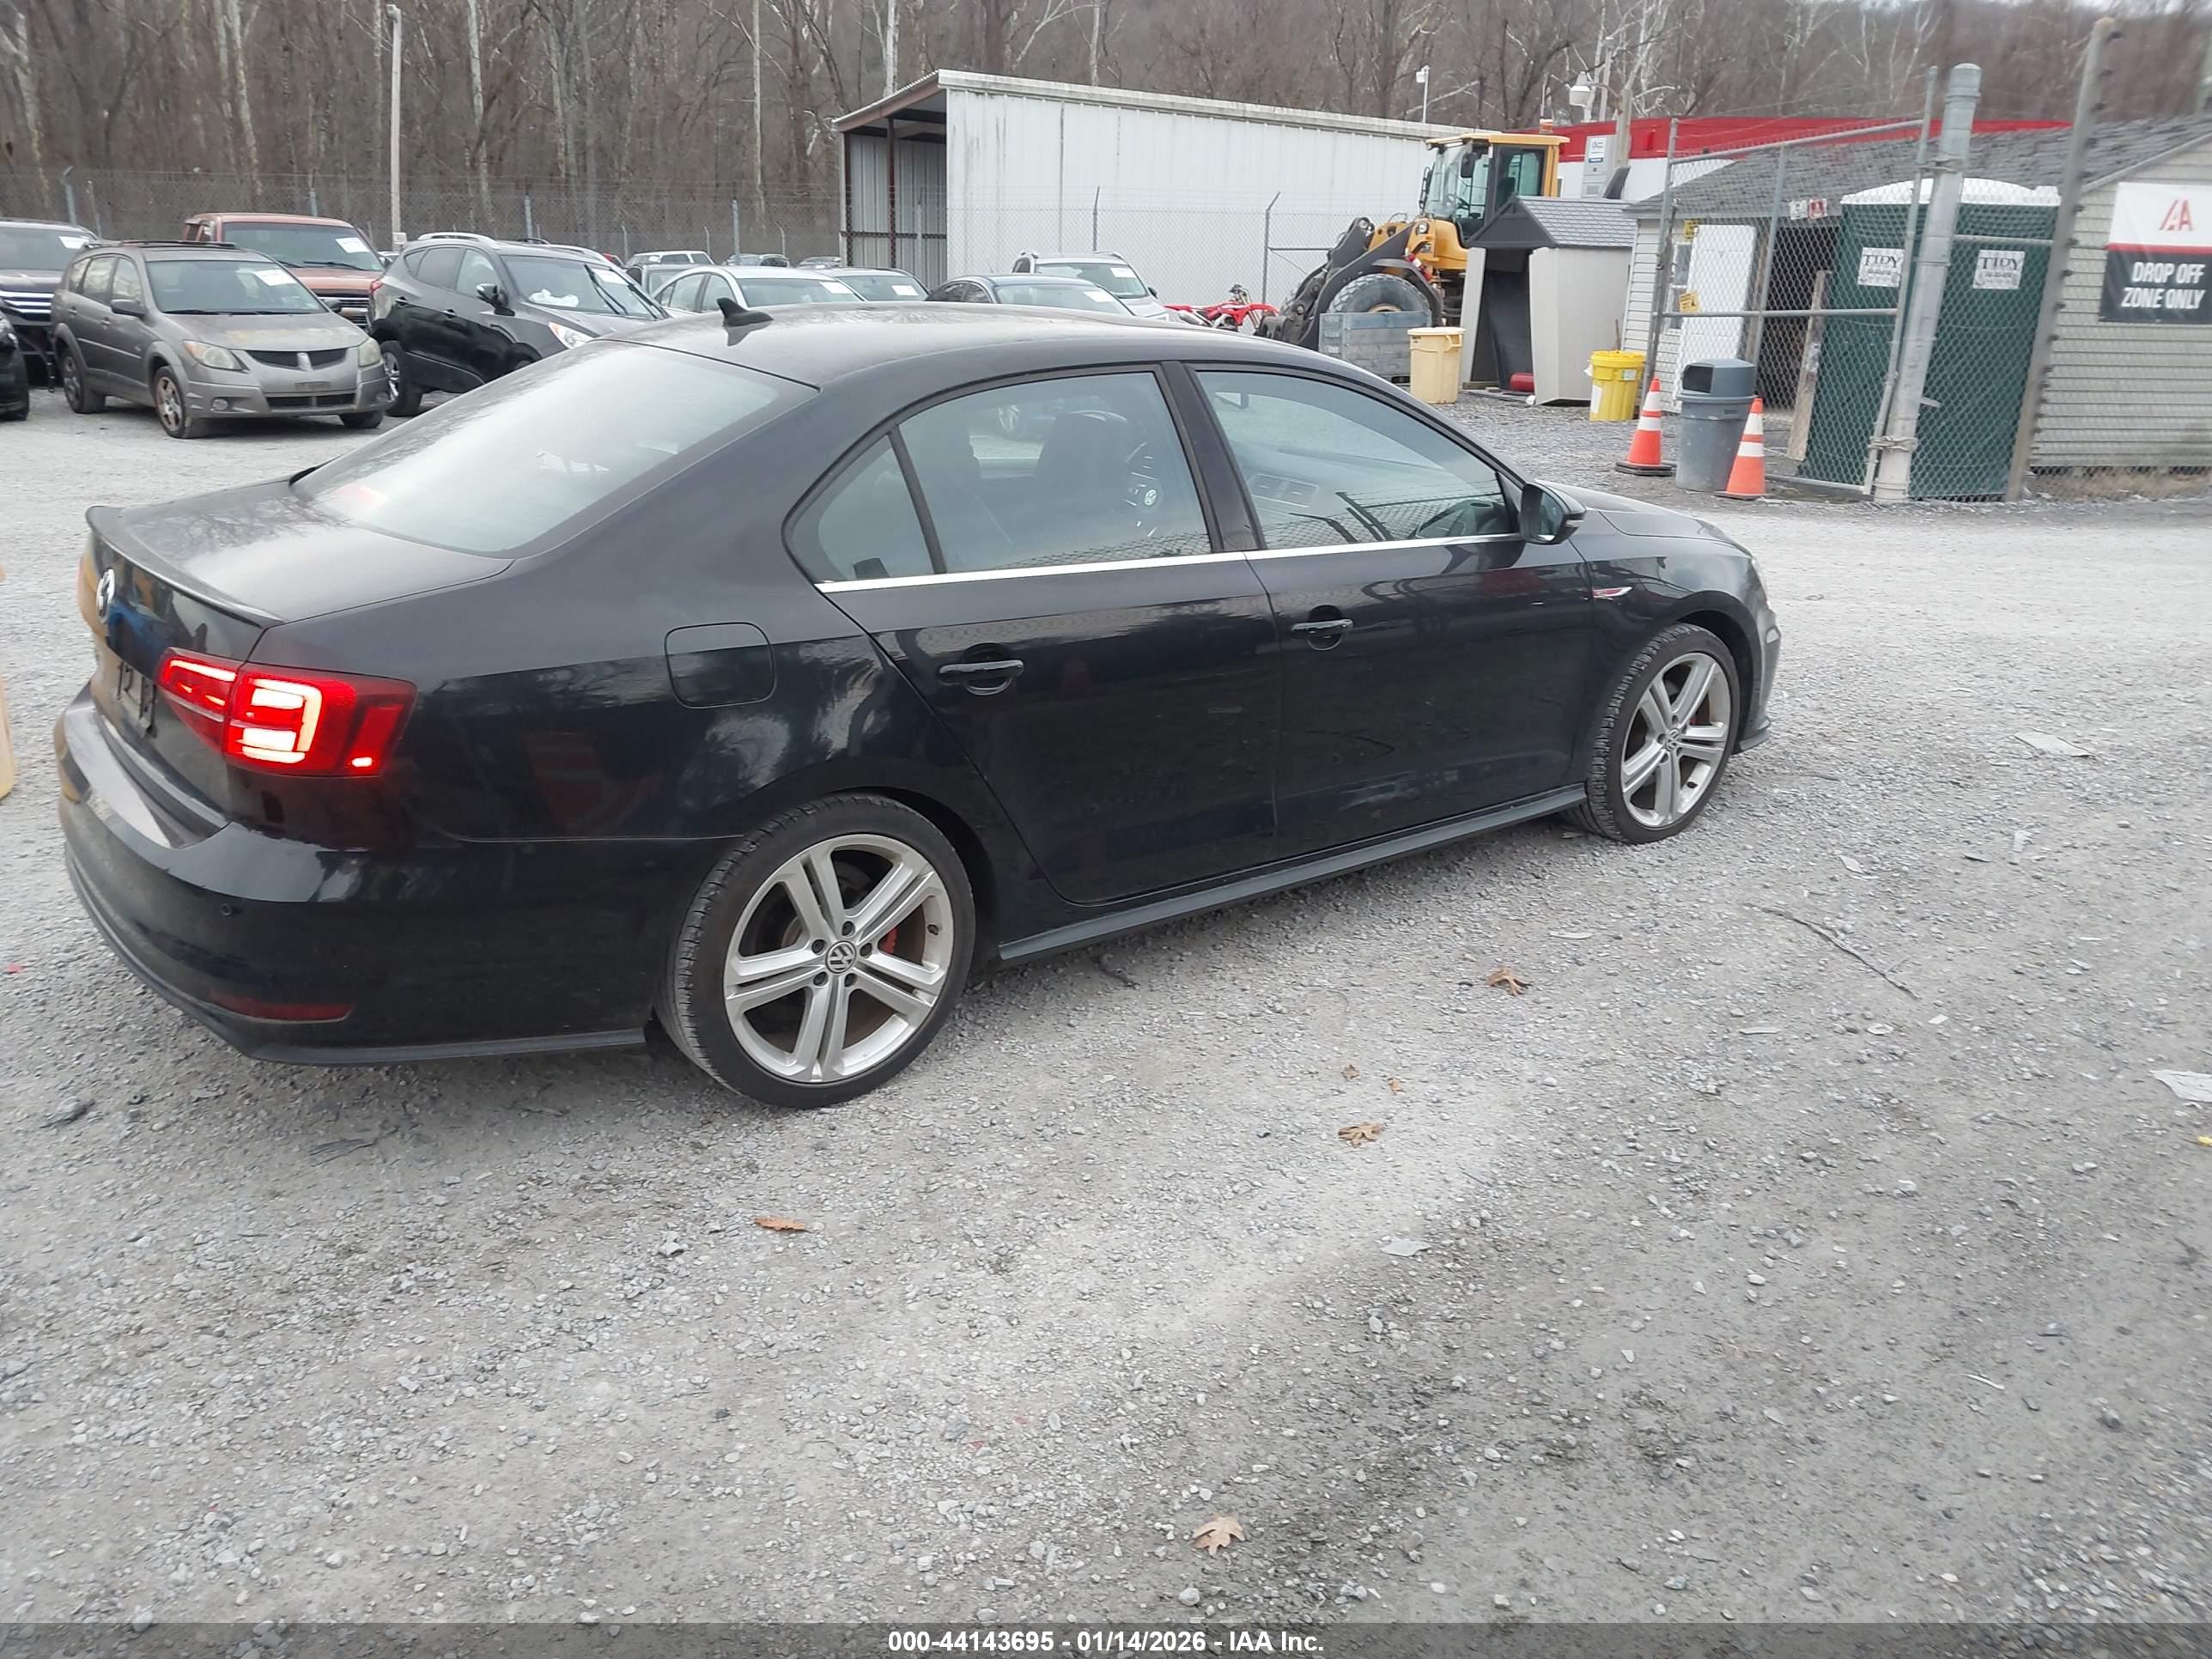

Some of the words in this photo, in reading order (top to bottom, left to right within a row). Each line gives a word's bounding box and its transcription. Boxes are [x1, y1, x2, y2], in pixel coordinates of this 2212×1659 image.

[1863, 254, 1901, 269] TIDY
[1979, 257, 2020, 270] TIDY
[2130, 261, 2175, 283] DROP
[2175, 263, 2206, 284] OFF
[2119, 286, 2165, 308] ZONE
[2165, 289, 2206, 310] ONLY
